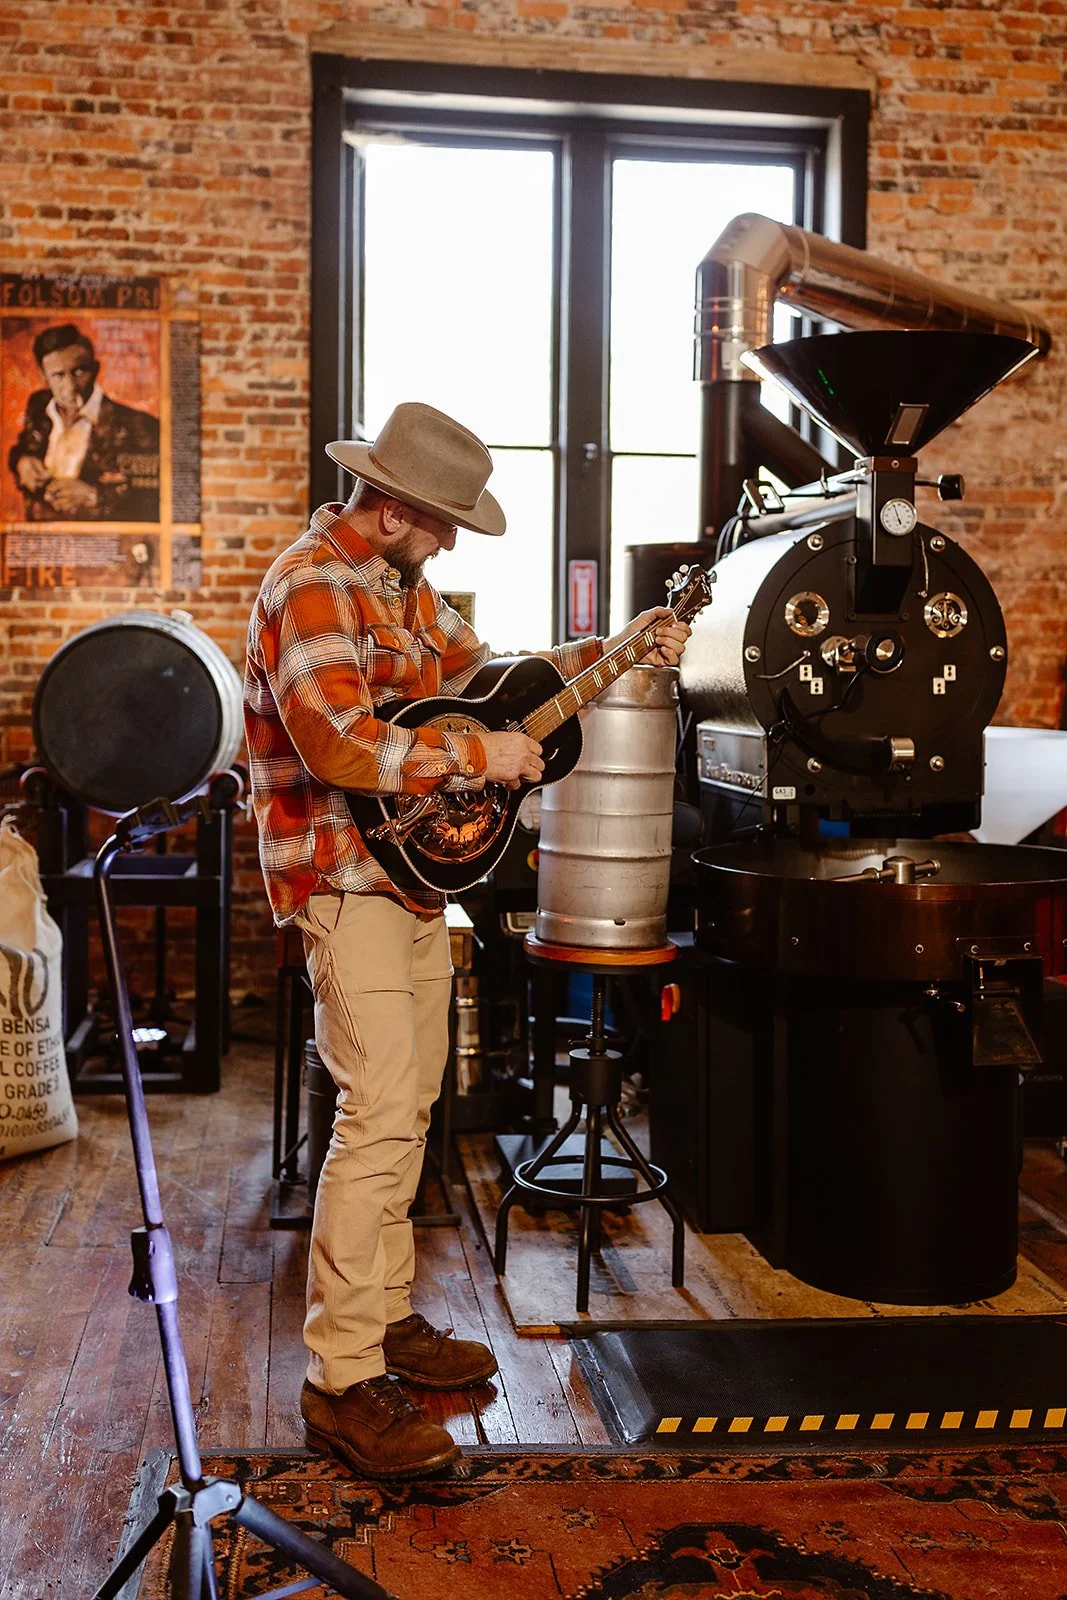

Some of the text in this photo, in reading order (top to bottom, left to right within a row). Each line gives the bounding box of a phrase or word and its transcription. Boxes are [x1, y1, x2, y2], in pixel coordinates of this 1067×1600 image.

[1, 282, 105, 307] FOLSOM
[3, 563, 77, 588] FIRE
[2, 1015, 50, 1034] BENSA
[14, 1041, 33, 1057] OF
[14, 1054, 59, 1077] COFFEE
[4, 1078, 52, 1100] GRADE
